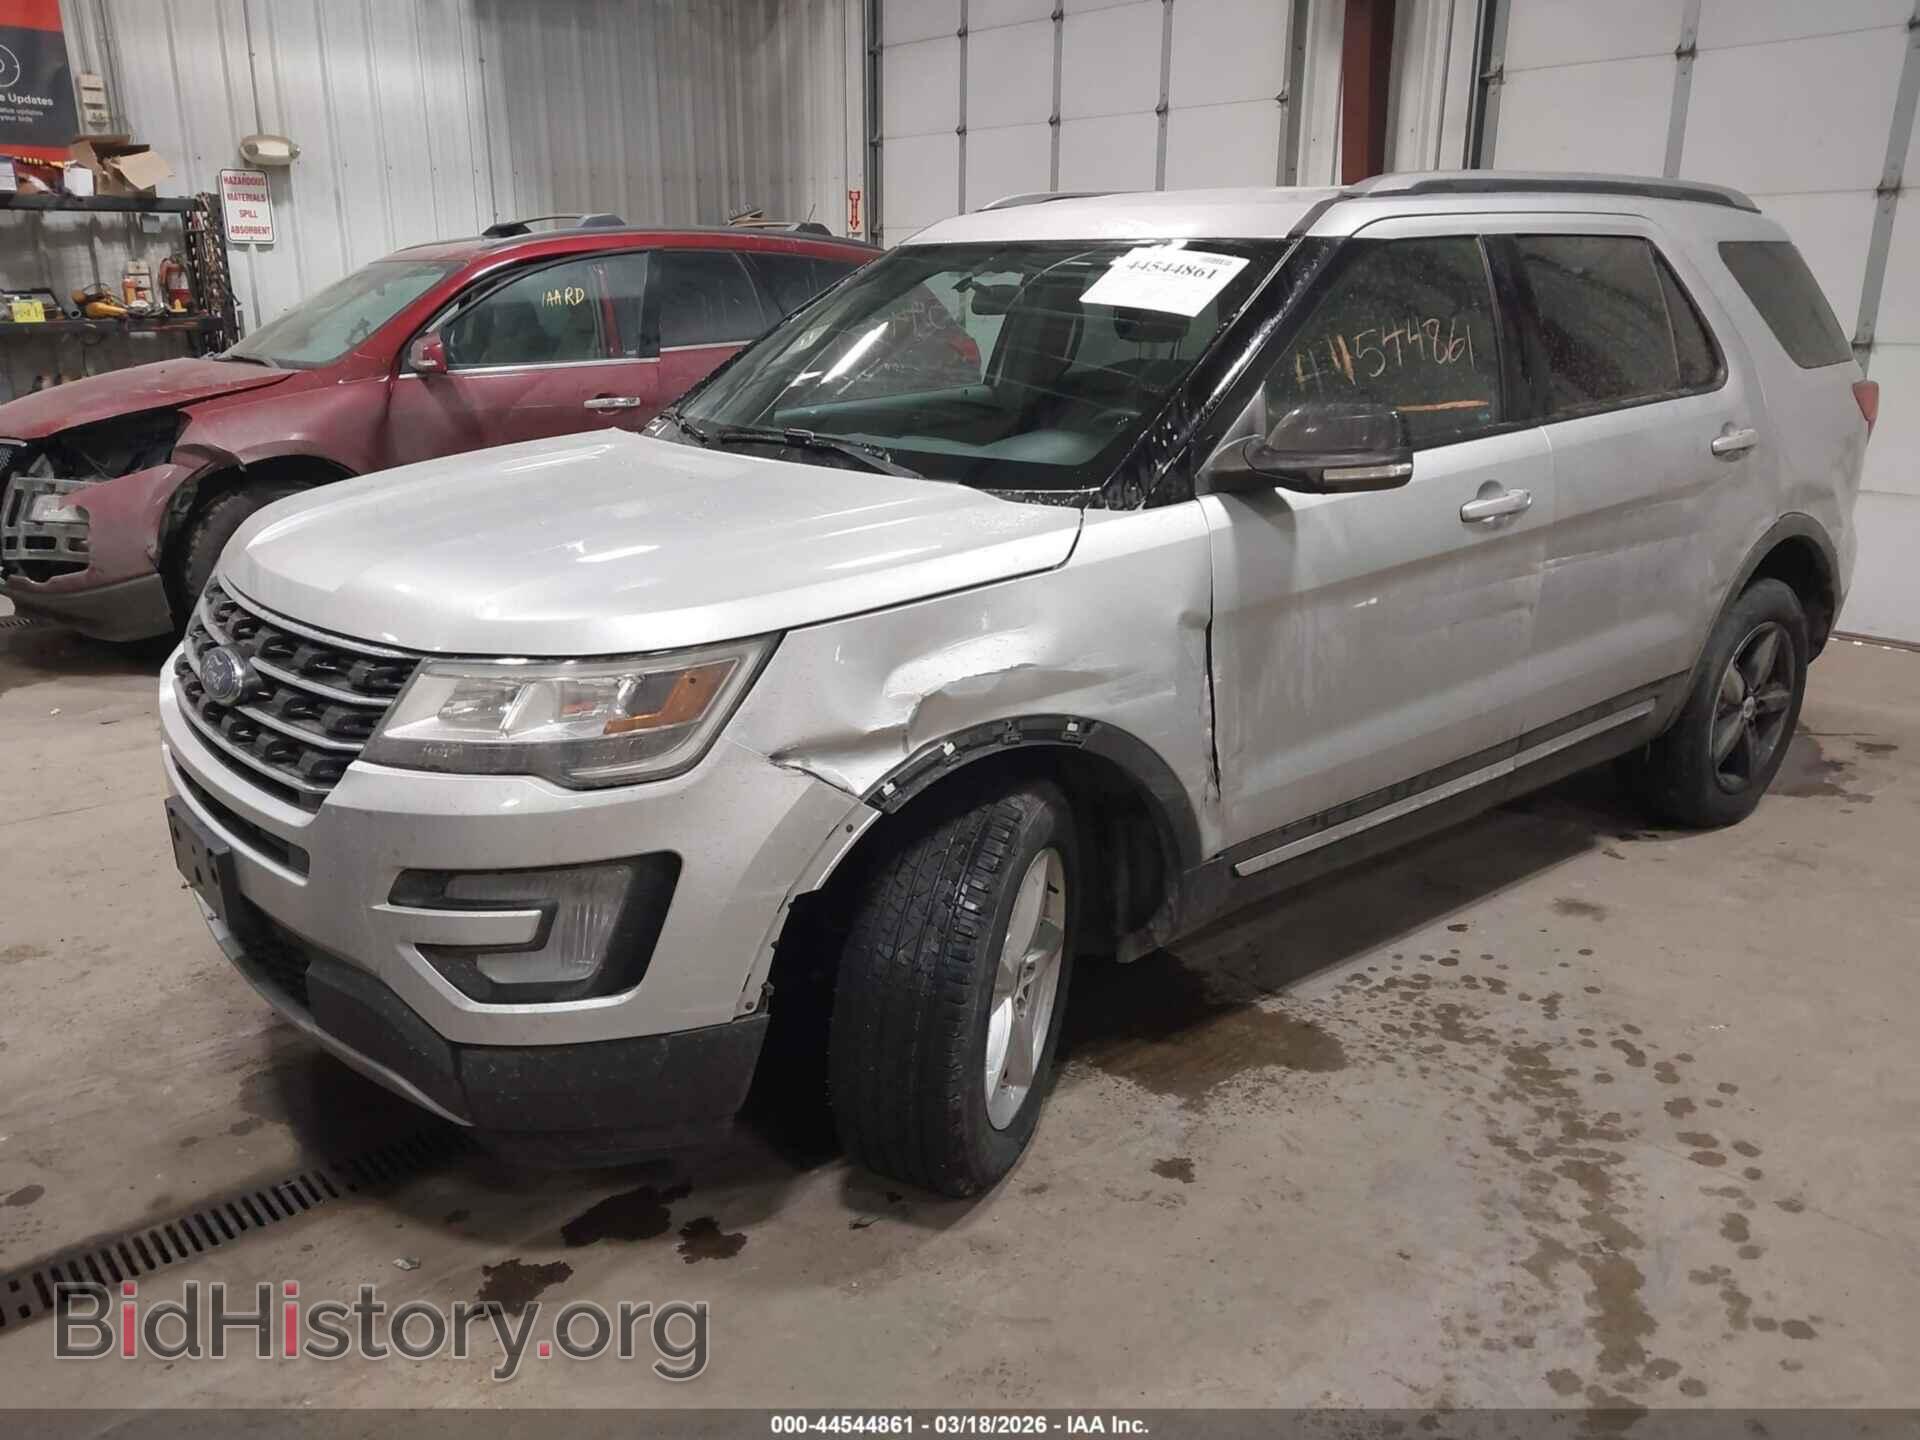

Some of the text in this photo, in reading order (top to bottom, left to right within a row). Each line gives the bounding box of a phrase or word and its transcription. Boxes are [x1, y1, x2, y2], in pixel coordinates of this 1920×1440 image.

[8, 92, 54, 106] Updates
[223, 176, 266, 186] HAZARDOUS
[227, 192, 266, 202] MATERIALS
[239, 209, 258, 218] SPILL
[230, 225, 271, 235] ABSORBENT
[1127, 260, 1218, 280] 44544861
